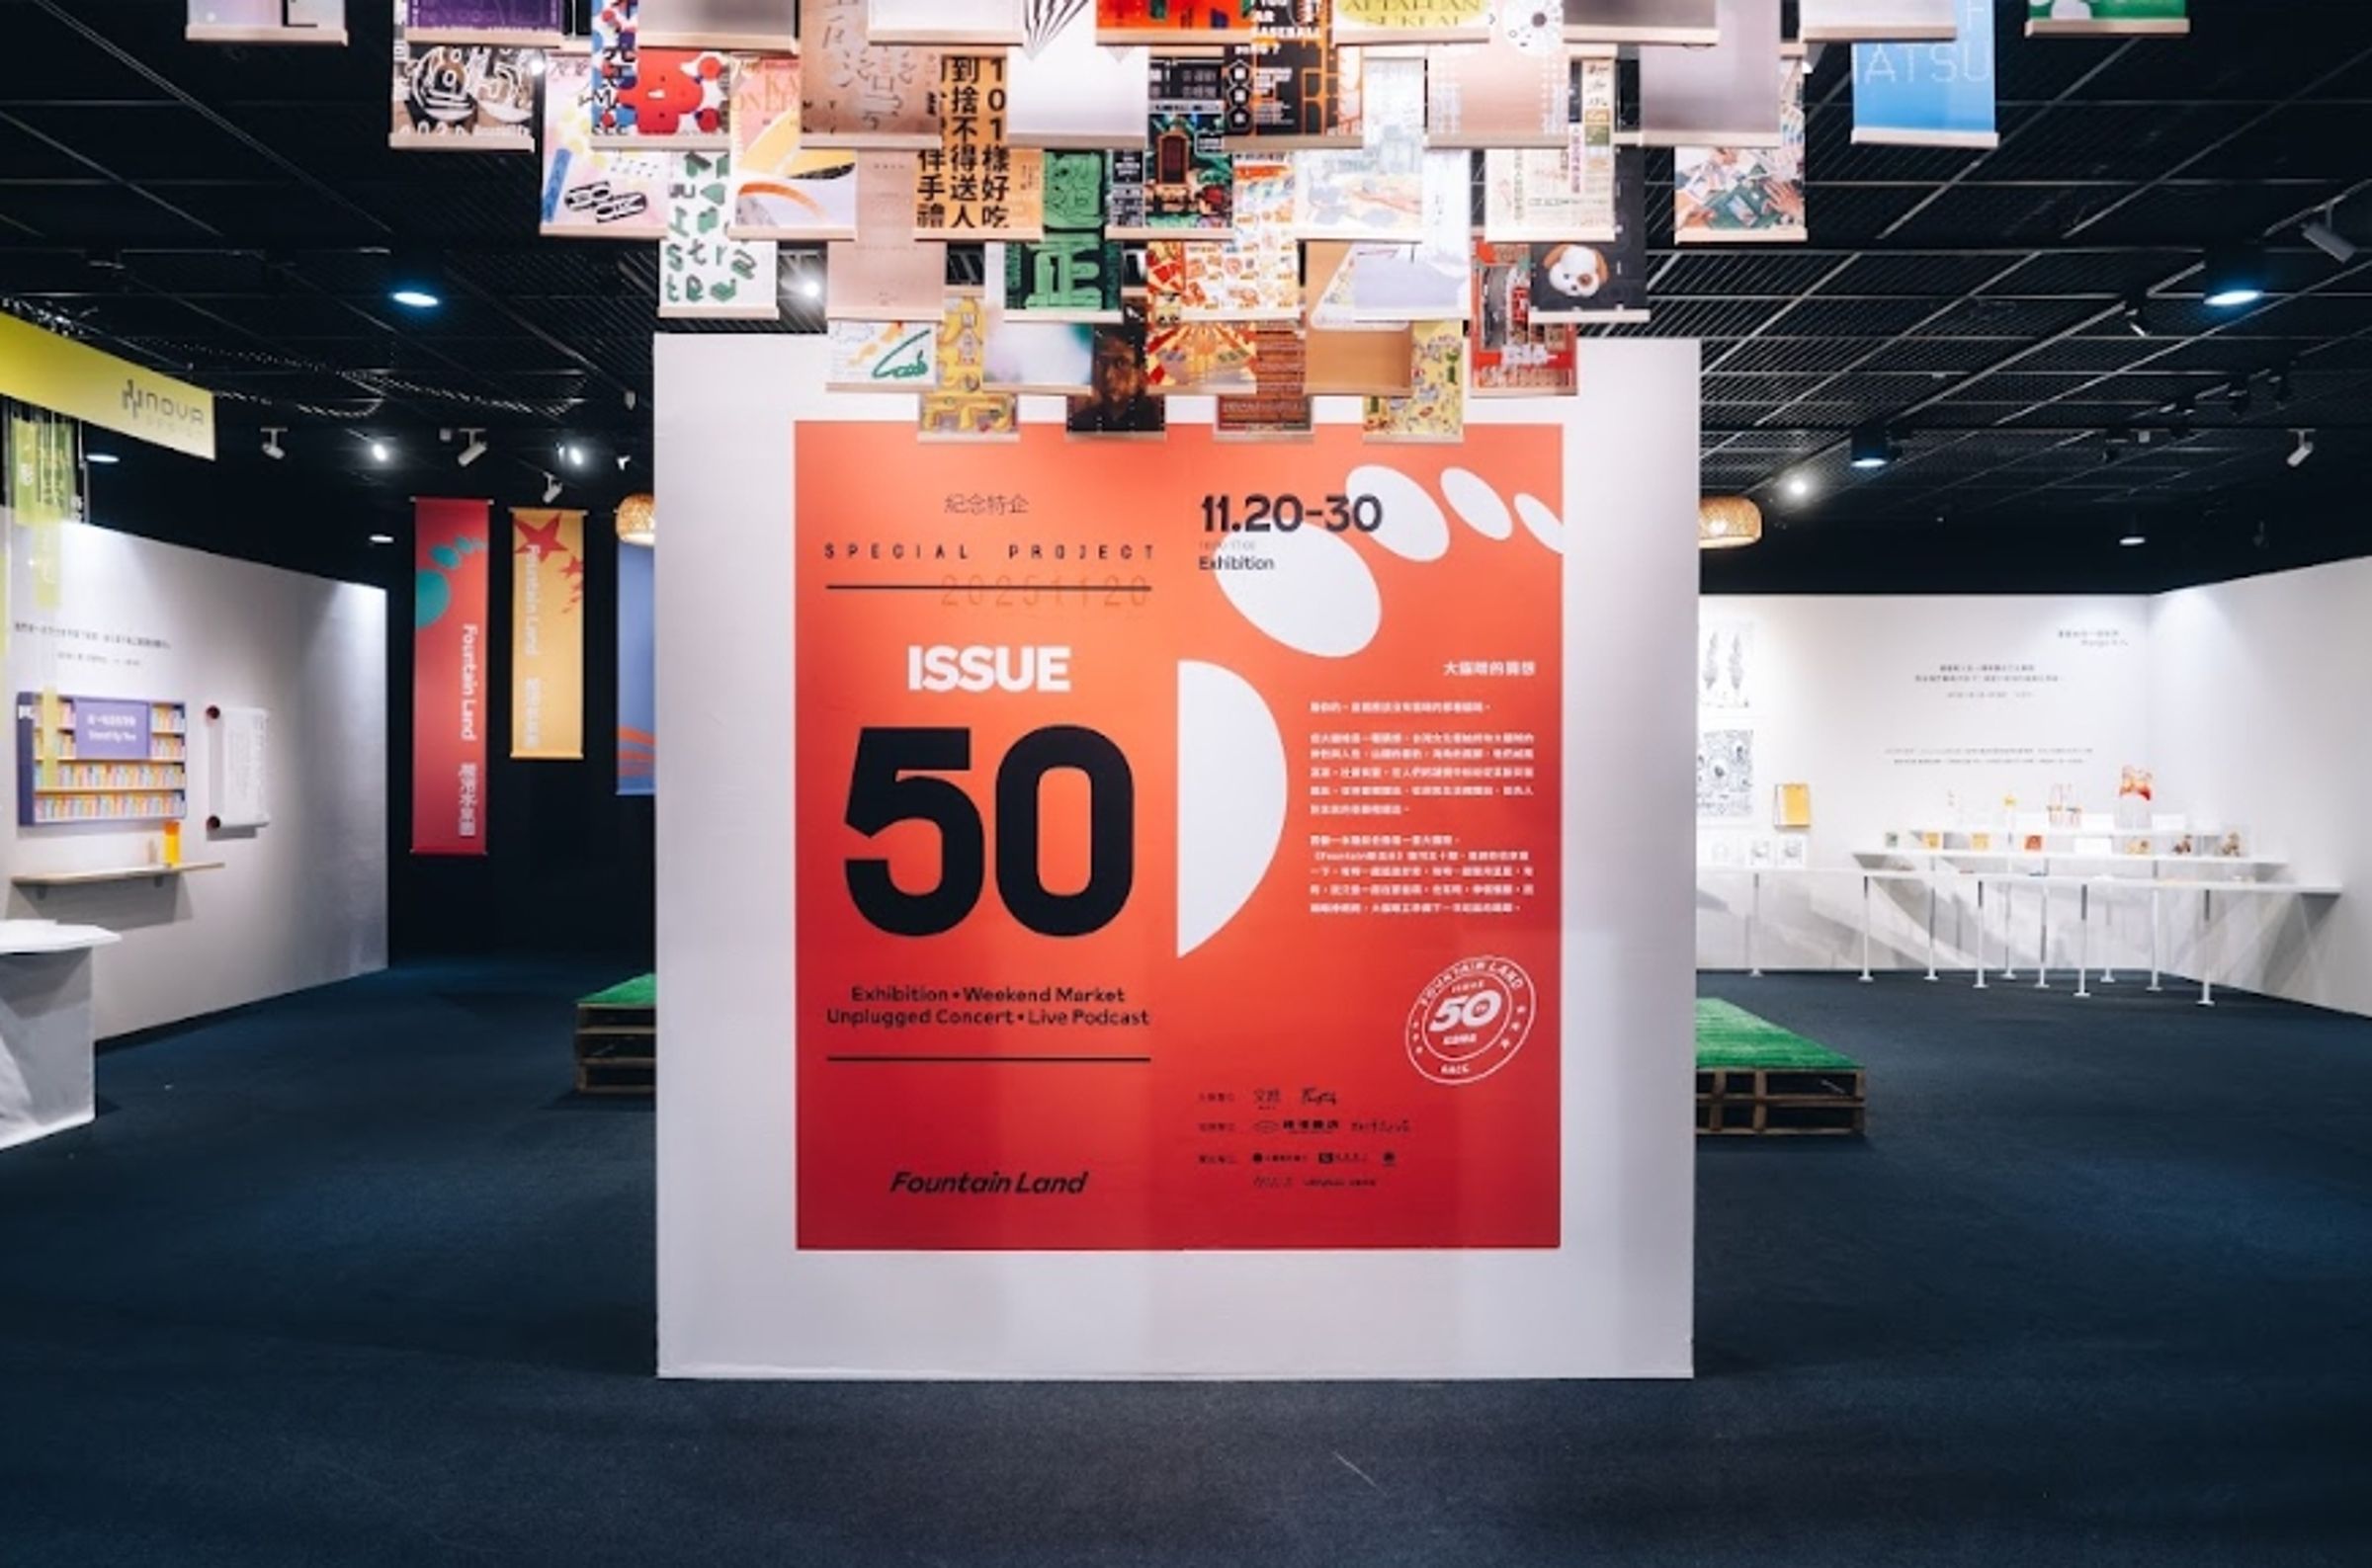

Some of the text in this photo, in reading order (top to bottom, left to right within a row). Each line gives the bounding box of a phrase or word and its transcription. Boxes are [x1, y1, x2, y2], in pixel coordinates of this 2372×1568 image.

[950, 56, 978, 229] 到捨不得送人
[1201, 493, 1384, 535] 11.20-30
[824, 542, 1155, 561] SPECIAL PROJECT
[1198, 554, 1275, 571] Exhibition
[461, 624, 478, 696] Fountain
[907, 644, 1071, 694] ISSUE
[845, 724, 1135, 939] 50
[851, 986, 1126, 1003] Exhibition Weekend Market
[1429, 989, 1502, 1032] 50
[827, 1009, 1149, 1029] Unplugged Concert Live Podcast
[890, 1171, 1089, 1196] Fountain Land
